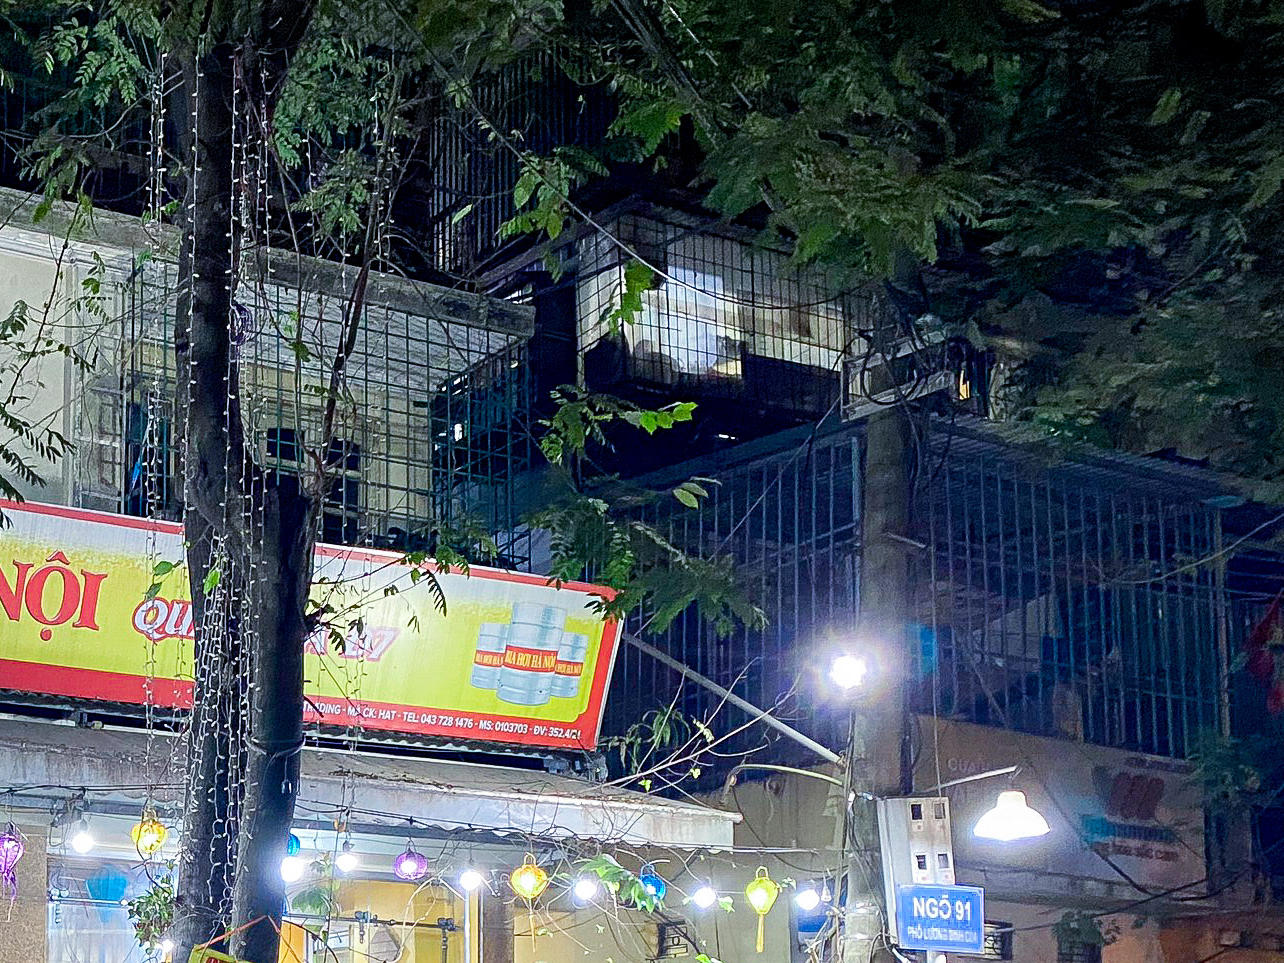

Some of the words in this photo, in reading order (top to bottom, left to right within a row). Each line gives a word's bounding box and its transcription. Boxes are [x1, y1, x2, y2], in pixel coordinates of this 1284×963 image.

[378, 709, 397, 719] HAT
[420, 713, 437, 725] 043
[438, 715, 453, 727] 728
[454, 717, 473, 729] 1476
[478, 719, 494, 731] MS:
[494, 721, 528, 734] 0103703
[913, 894, 952, 920] NGÕ
[956, 900, 971, 921] 91
